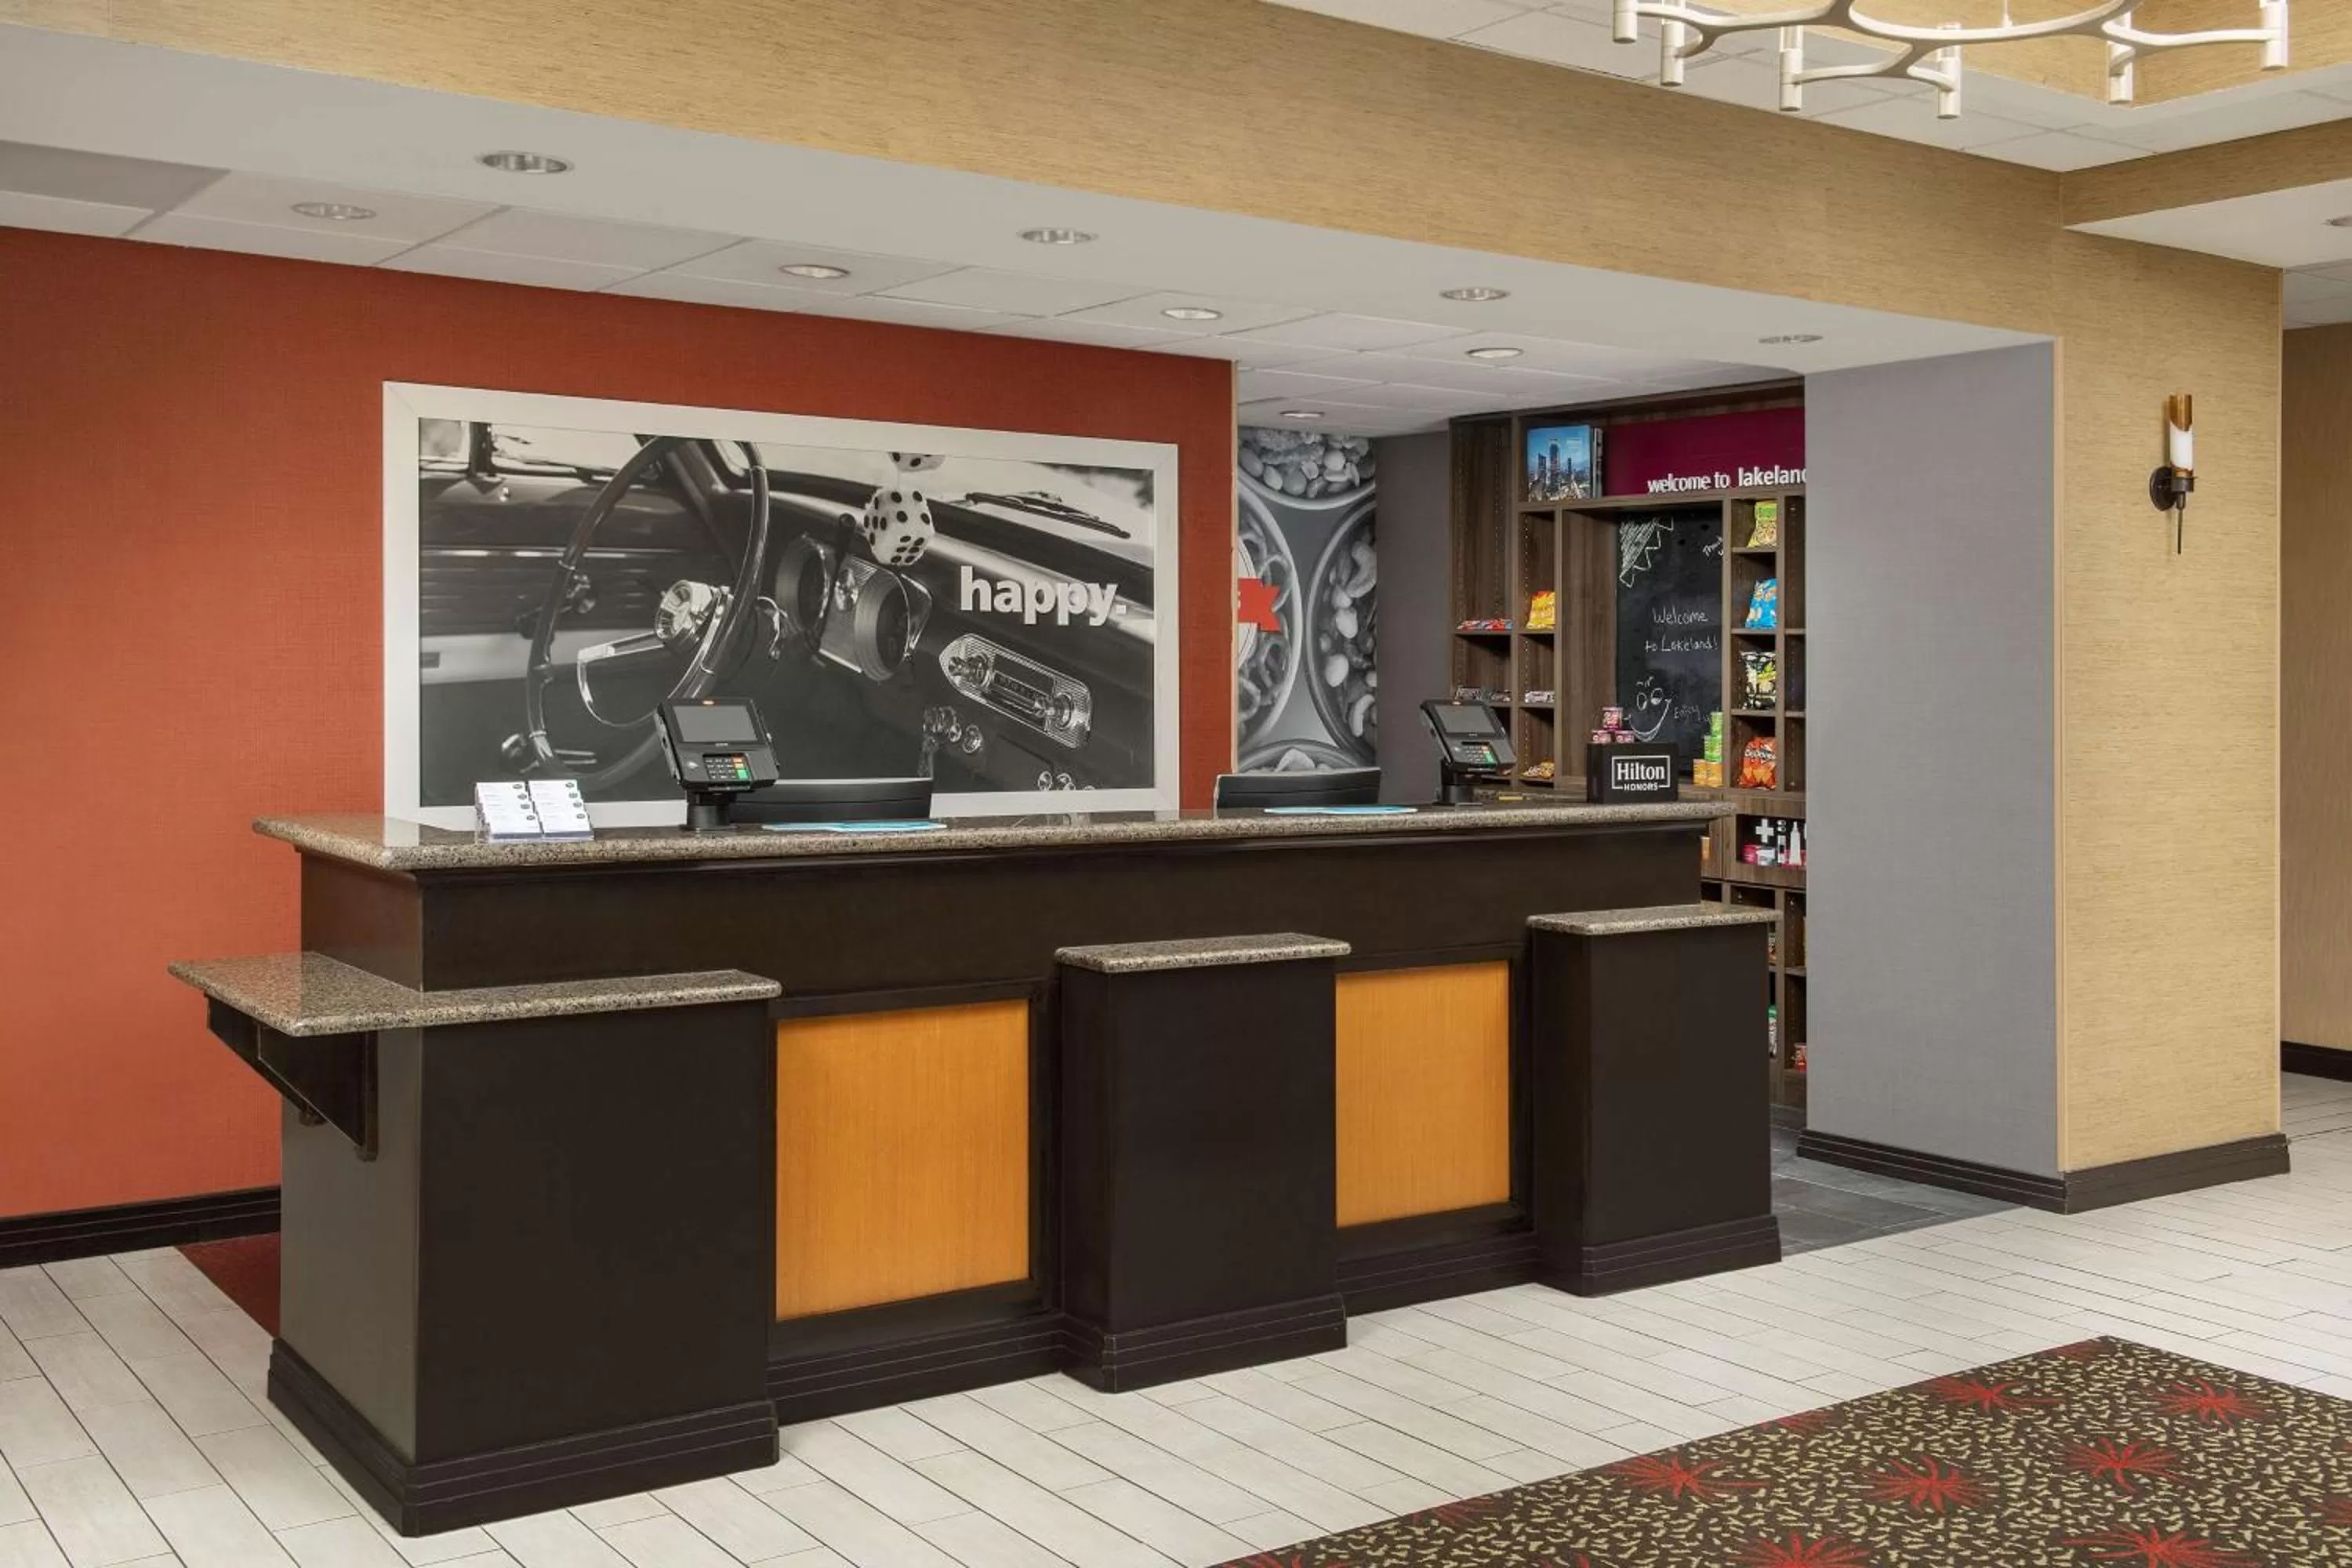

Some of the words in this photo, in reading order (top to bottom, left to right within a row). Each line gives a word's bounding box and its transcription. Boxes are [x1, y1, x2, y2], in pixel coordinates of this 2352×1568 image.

[1647, 473, 1711, 493] welcome
[1714, 471, 1731, 488] to
[960, 564, 1127, 626] happy.
[1652, 604, 1708, 625] Welcome
[1645, 640, 1658, 652] to
[1661, 633, 1719, 652] Lakeland!
[1617, 762, 1665, 781] Hilton
[1624, 782, 1658, 791] HONORS
